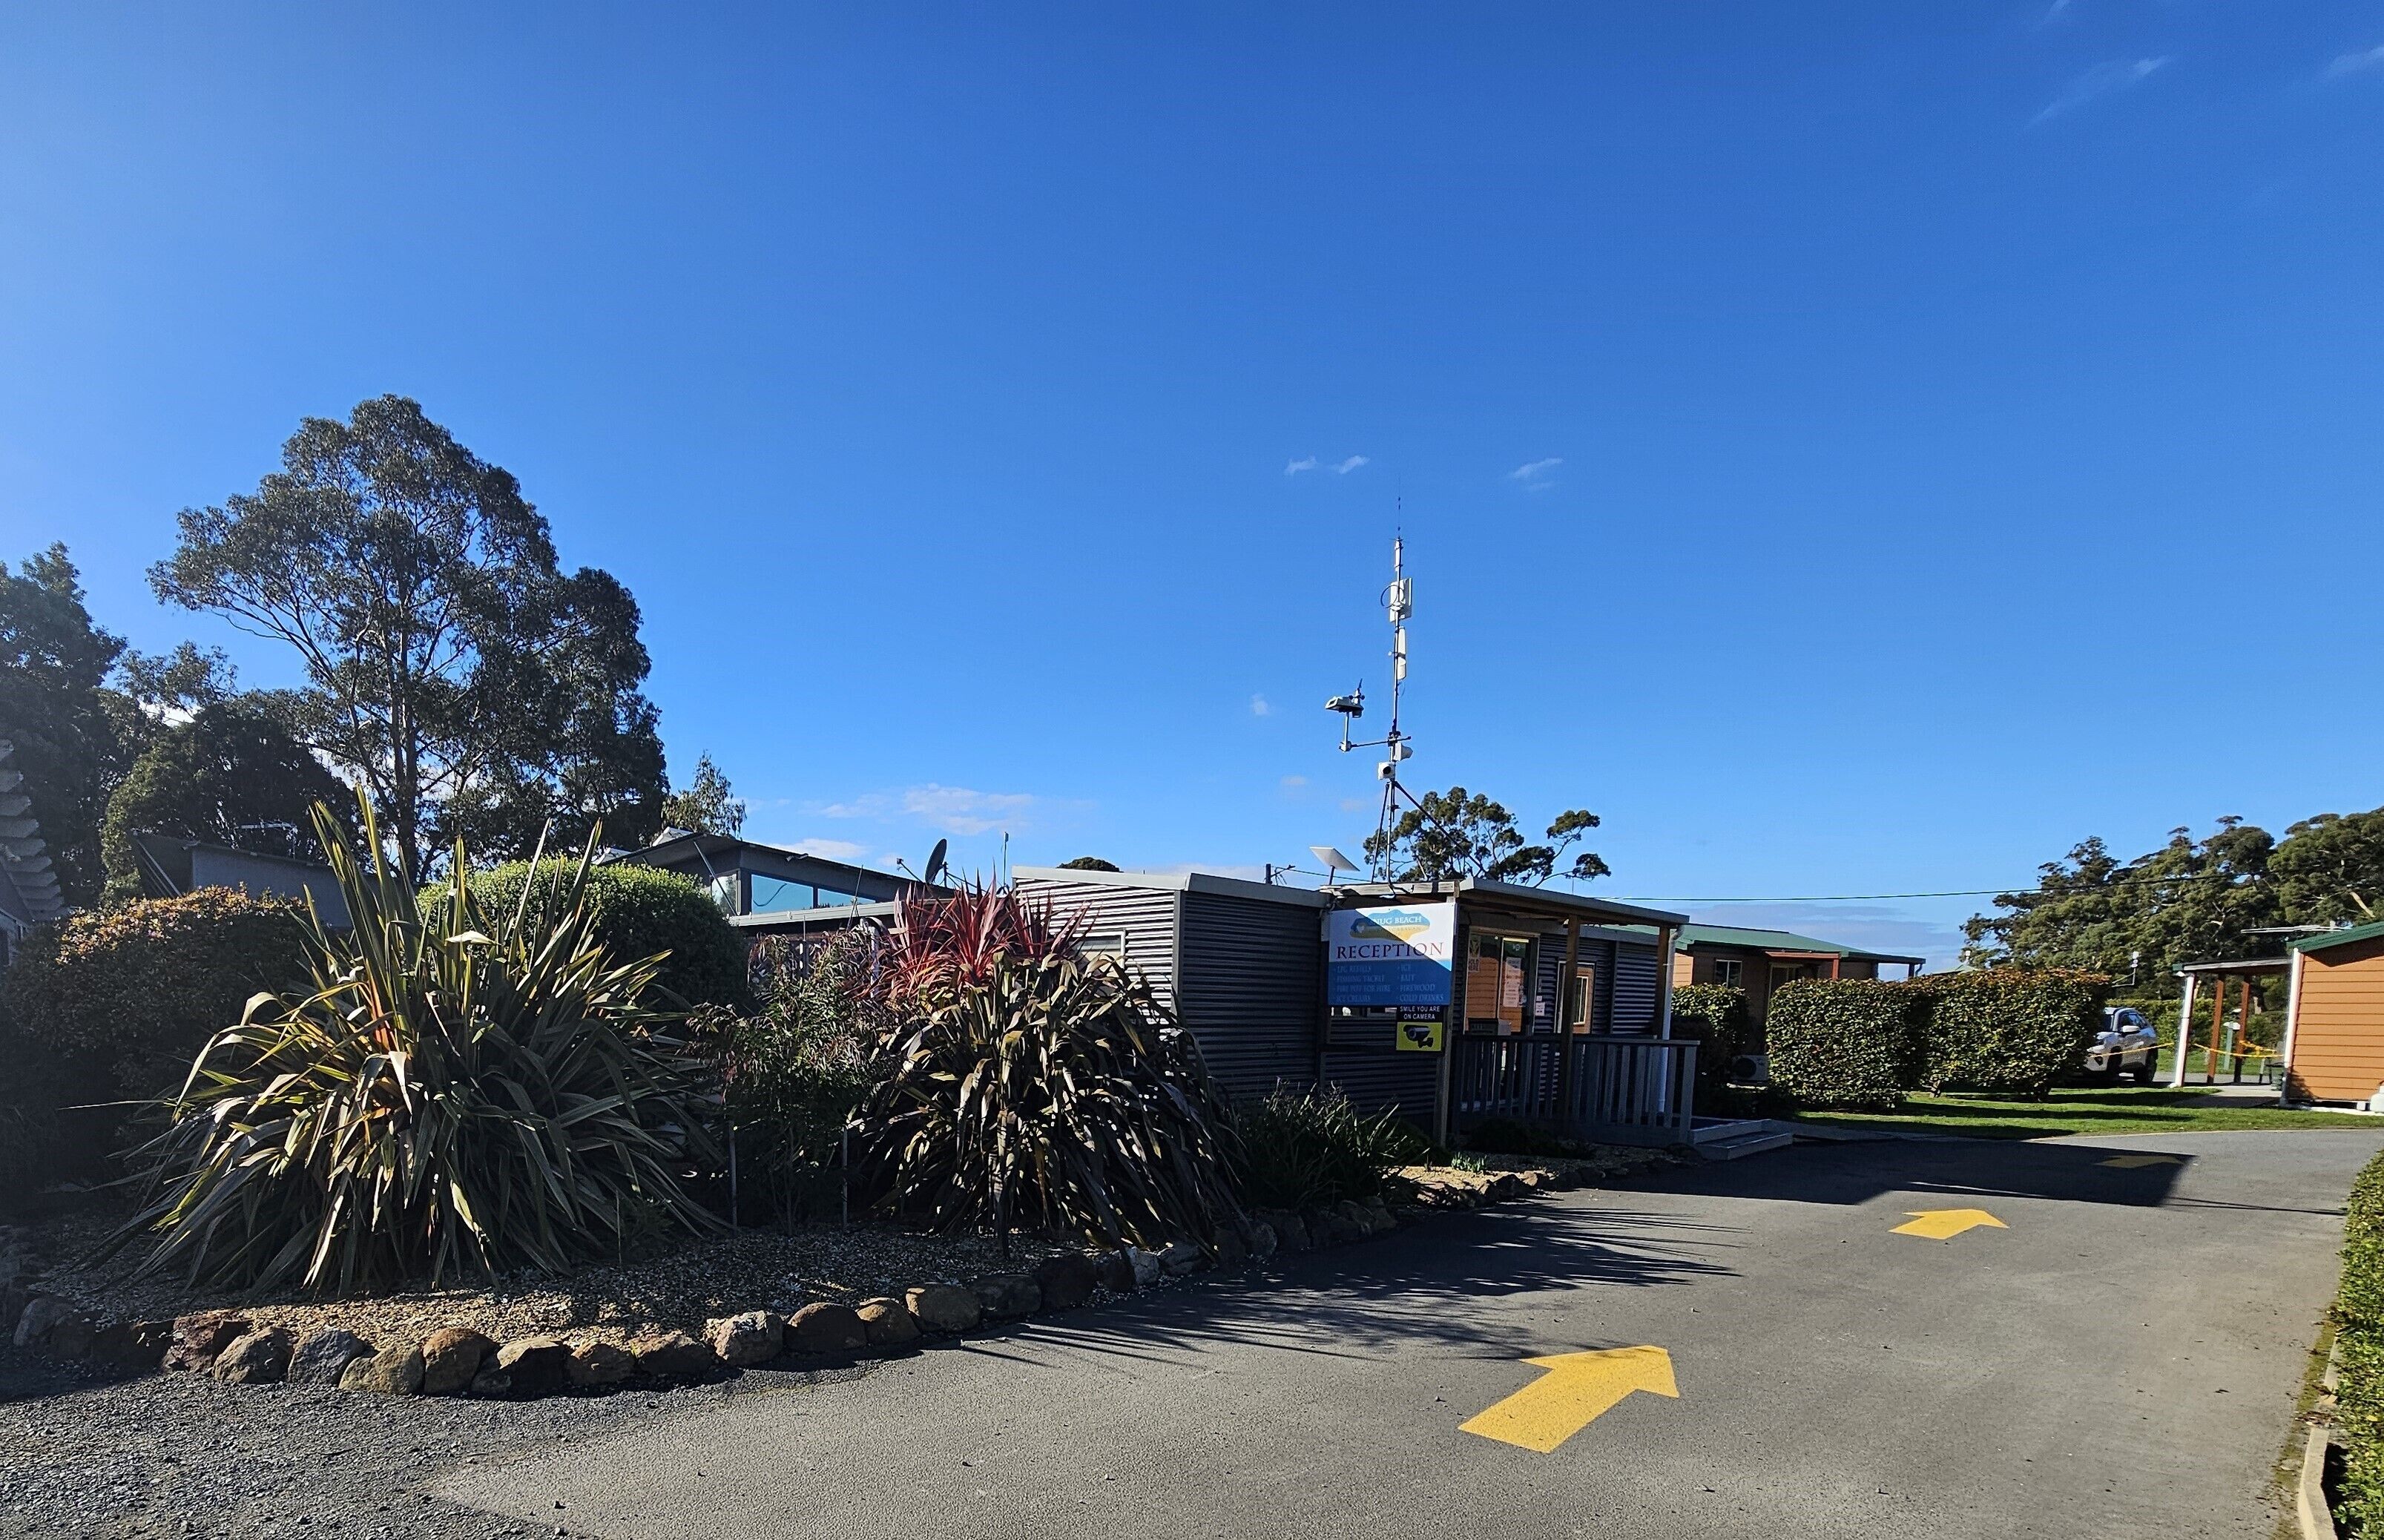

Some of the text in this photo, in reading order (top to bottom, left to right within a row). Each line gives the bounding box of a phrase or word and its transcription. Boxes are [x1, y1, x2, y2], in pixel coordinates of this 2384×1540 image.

[1370, 915, 1422, 925] NUG BEACH
[1336, 942, 1444, 959] RECEPTION
[1400, 984, 1436, 992] FIREWOOD
[1400, 993, 1444, 1003] COLD DRINKS
